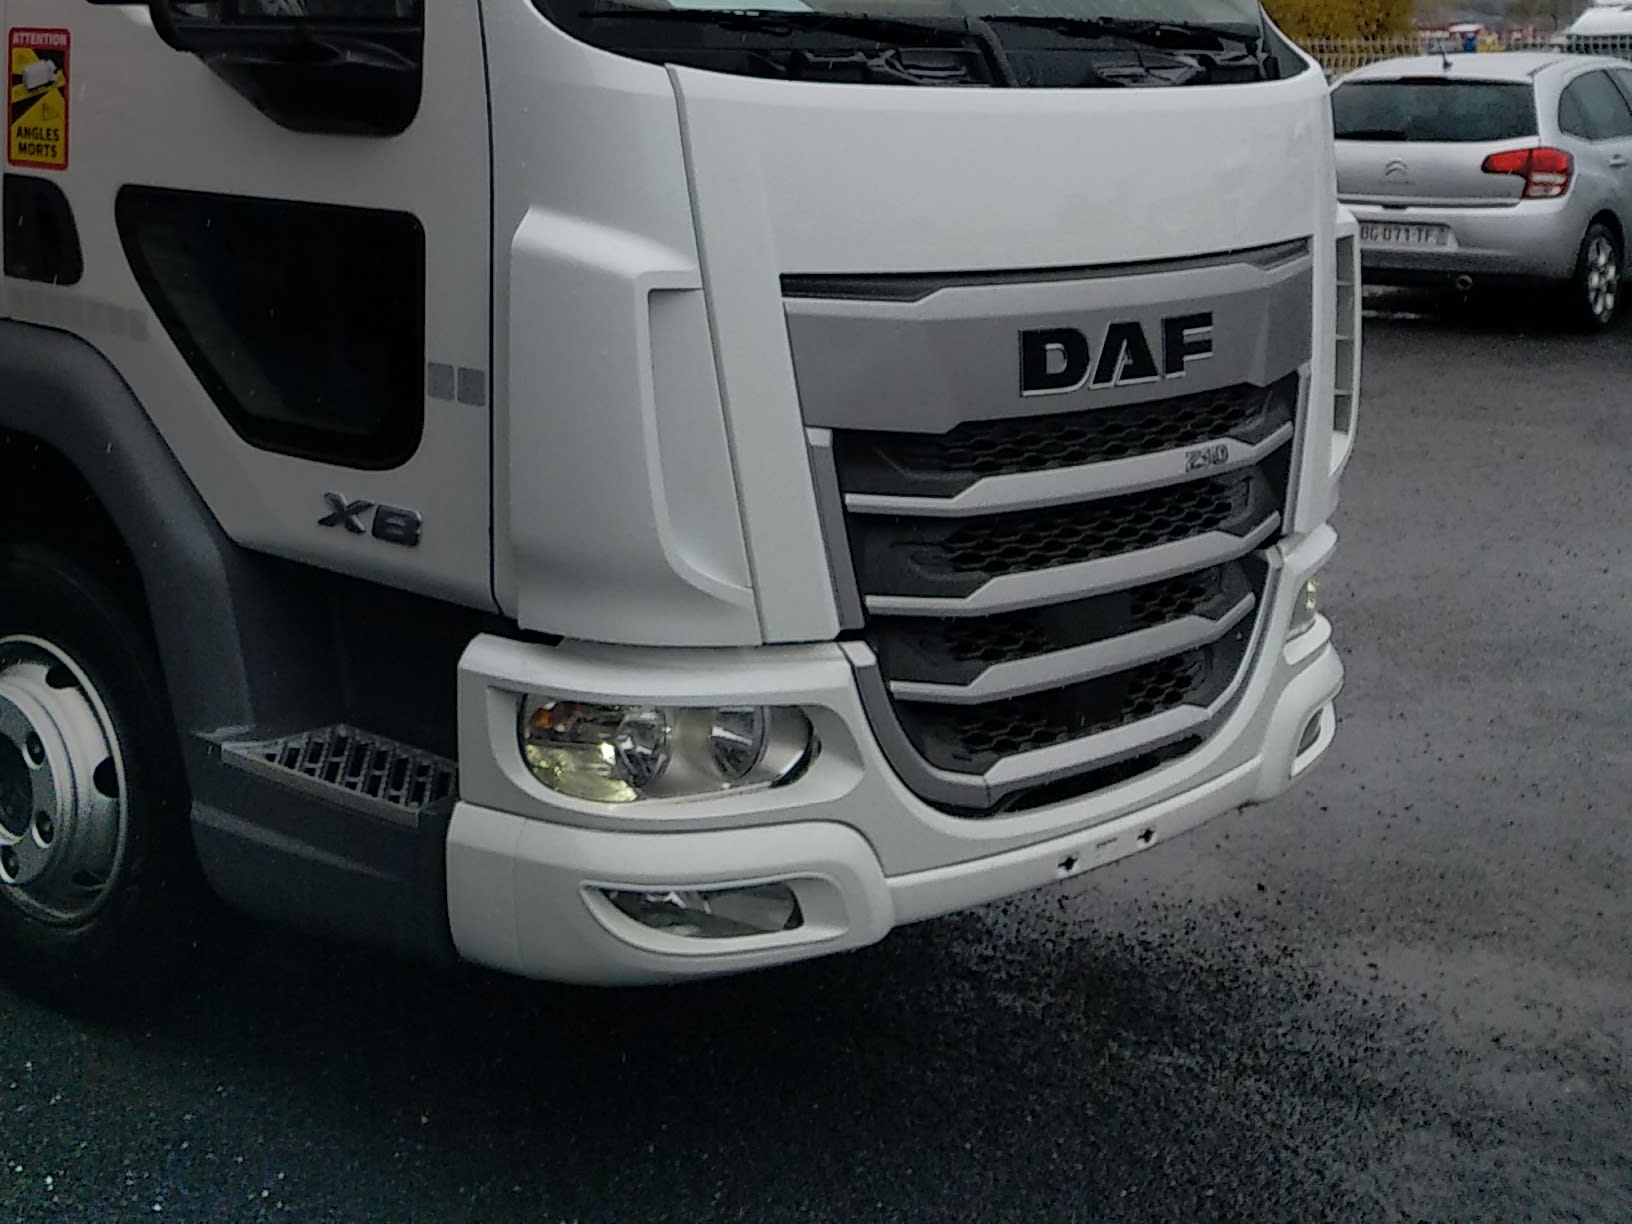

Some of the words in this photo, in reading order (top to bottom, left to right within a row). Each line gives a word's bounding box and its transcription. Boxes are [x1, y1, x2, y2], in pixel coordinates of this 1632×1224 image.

[12, 32, 67, 46] ATTENTION
[16, 126, 60, 142] ANGLES
[18, 142, 58, 158] MORTS
[1019, 312, 1214, 397] DAF
[318, 490, 423, 547] XB
